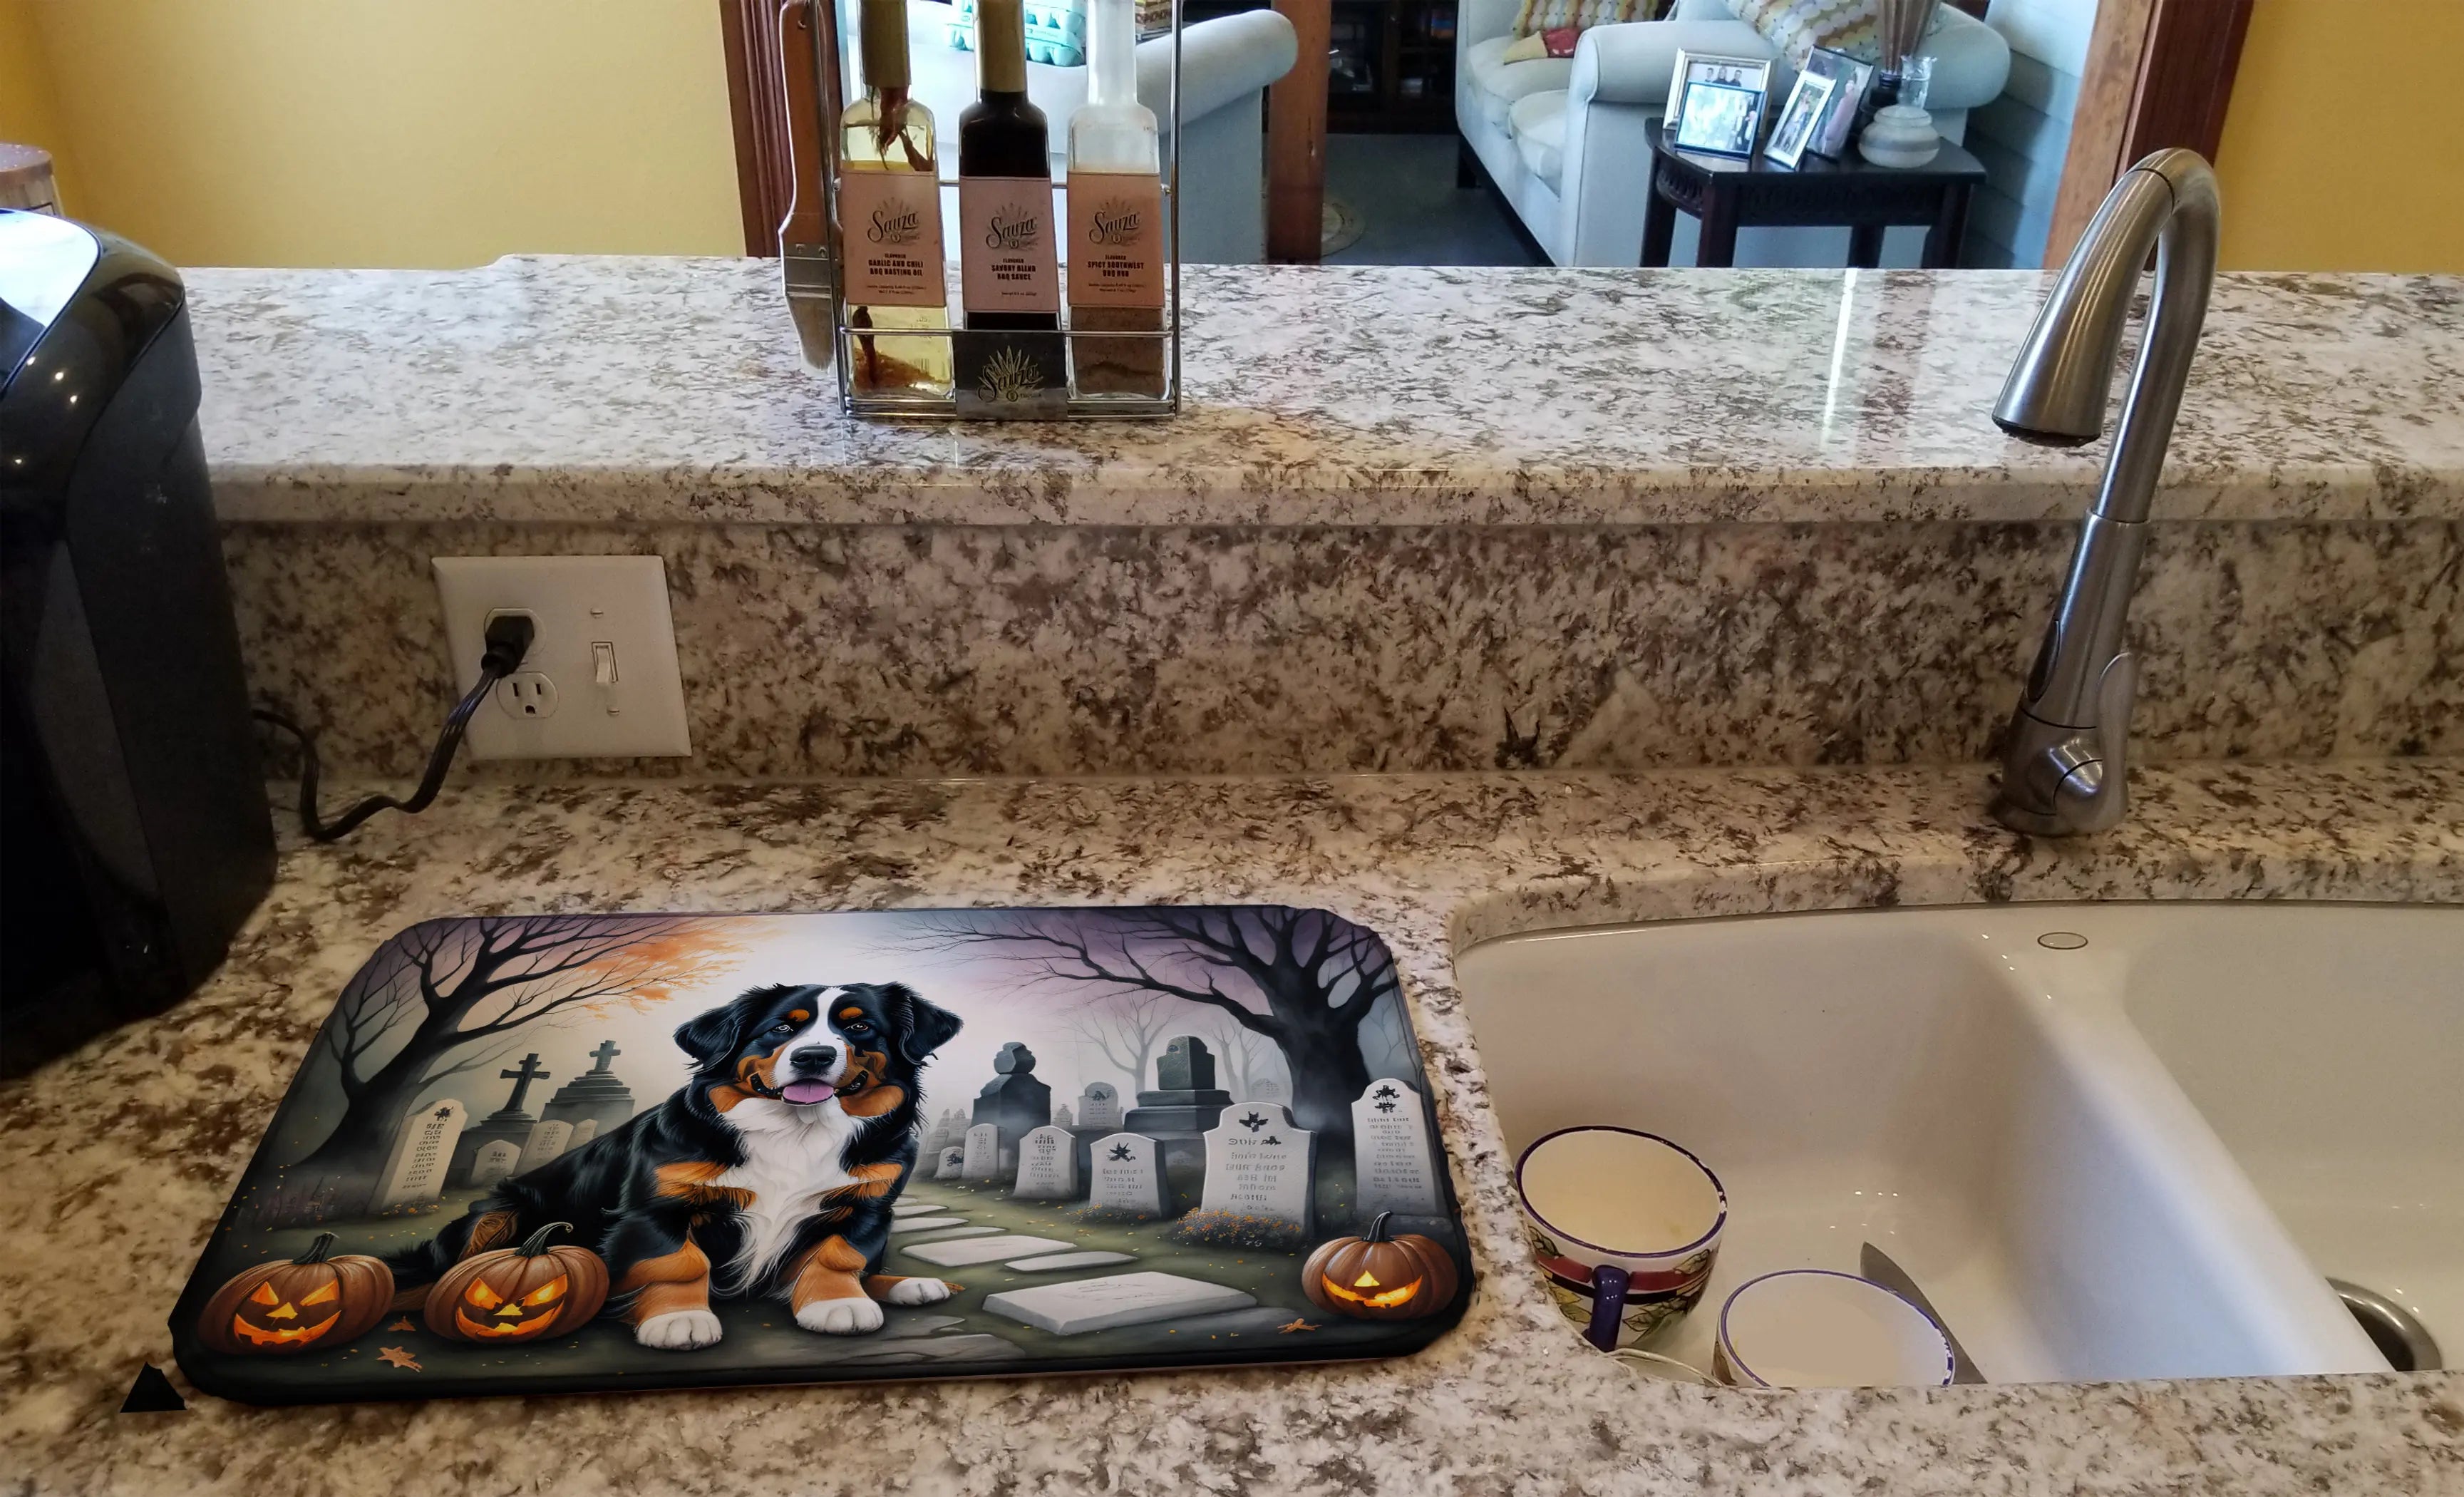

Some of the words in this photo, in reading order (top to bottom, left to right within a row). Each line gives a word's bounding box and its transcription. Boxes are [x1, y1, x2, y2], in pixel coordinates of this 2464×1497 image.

[867, 210, 919, 243] Sauza
[986, 216, 1036, 249] Sauza
[1088, 211, 1140, 245] Sauza
